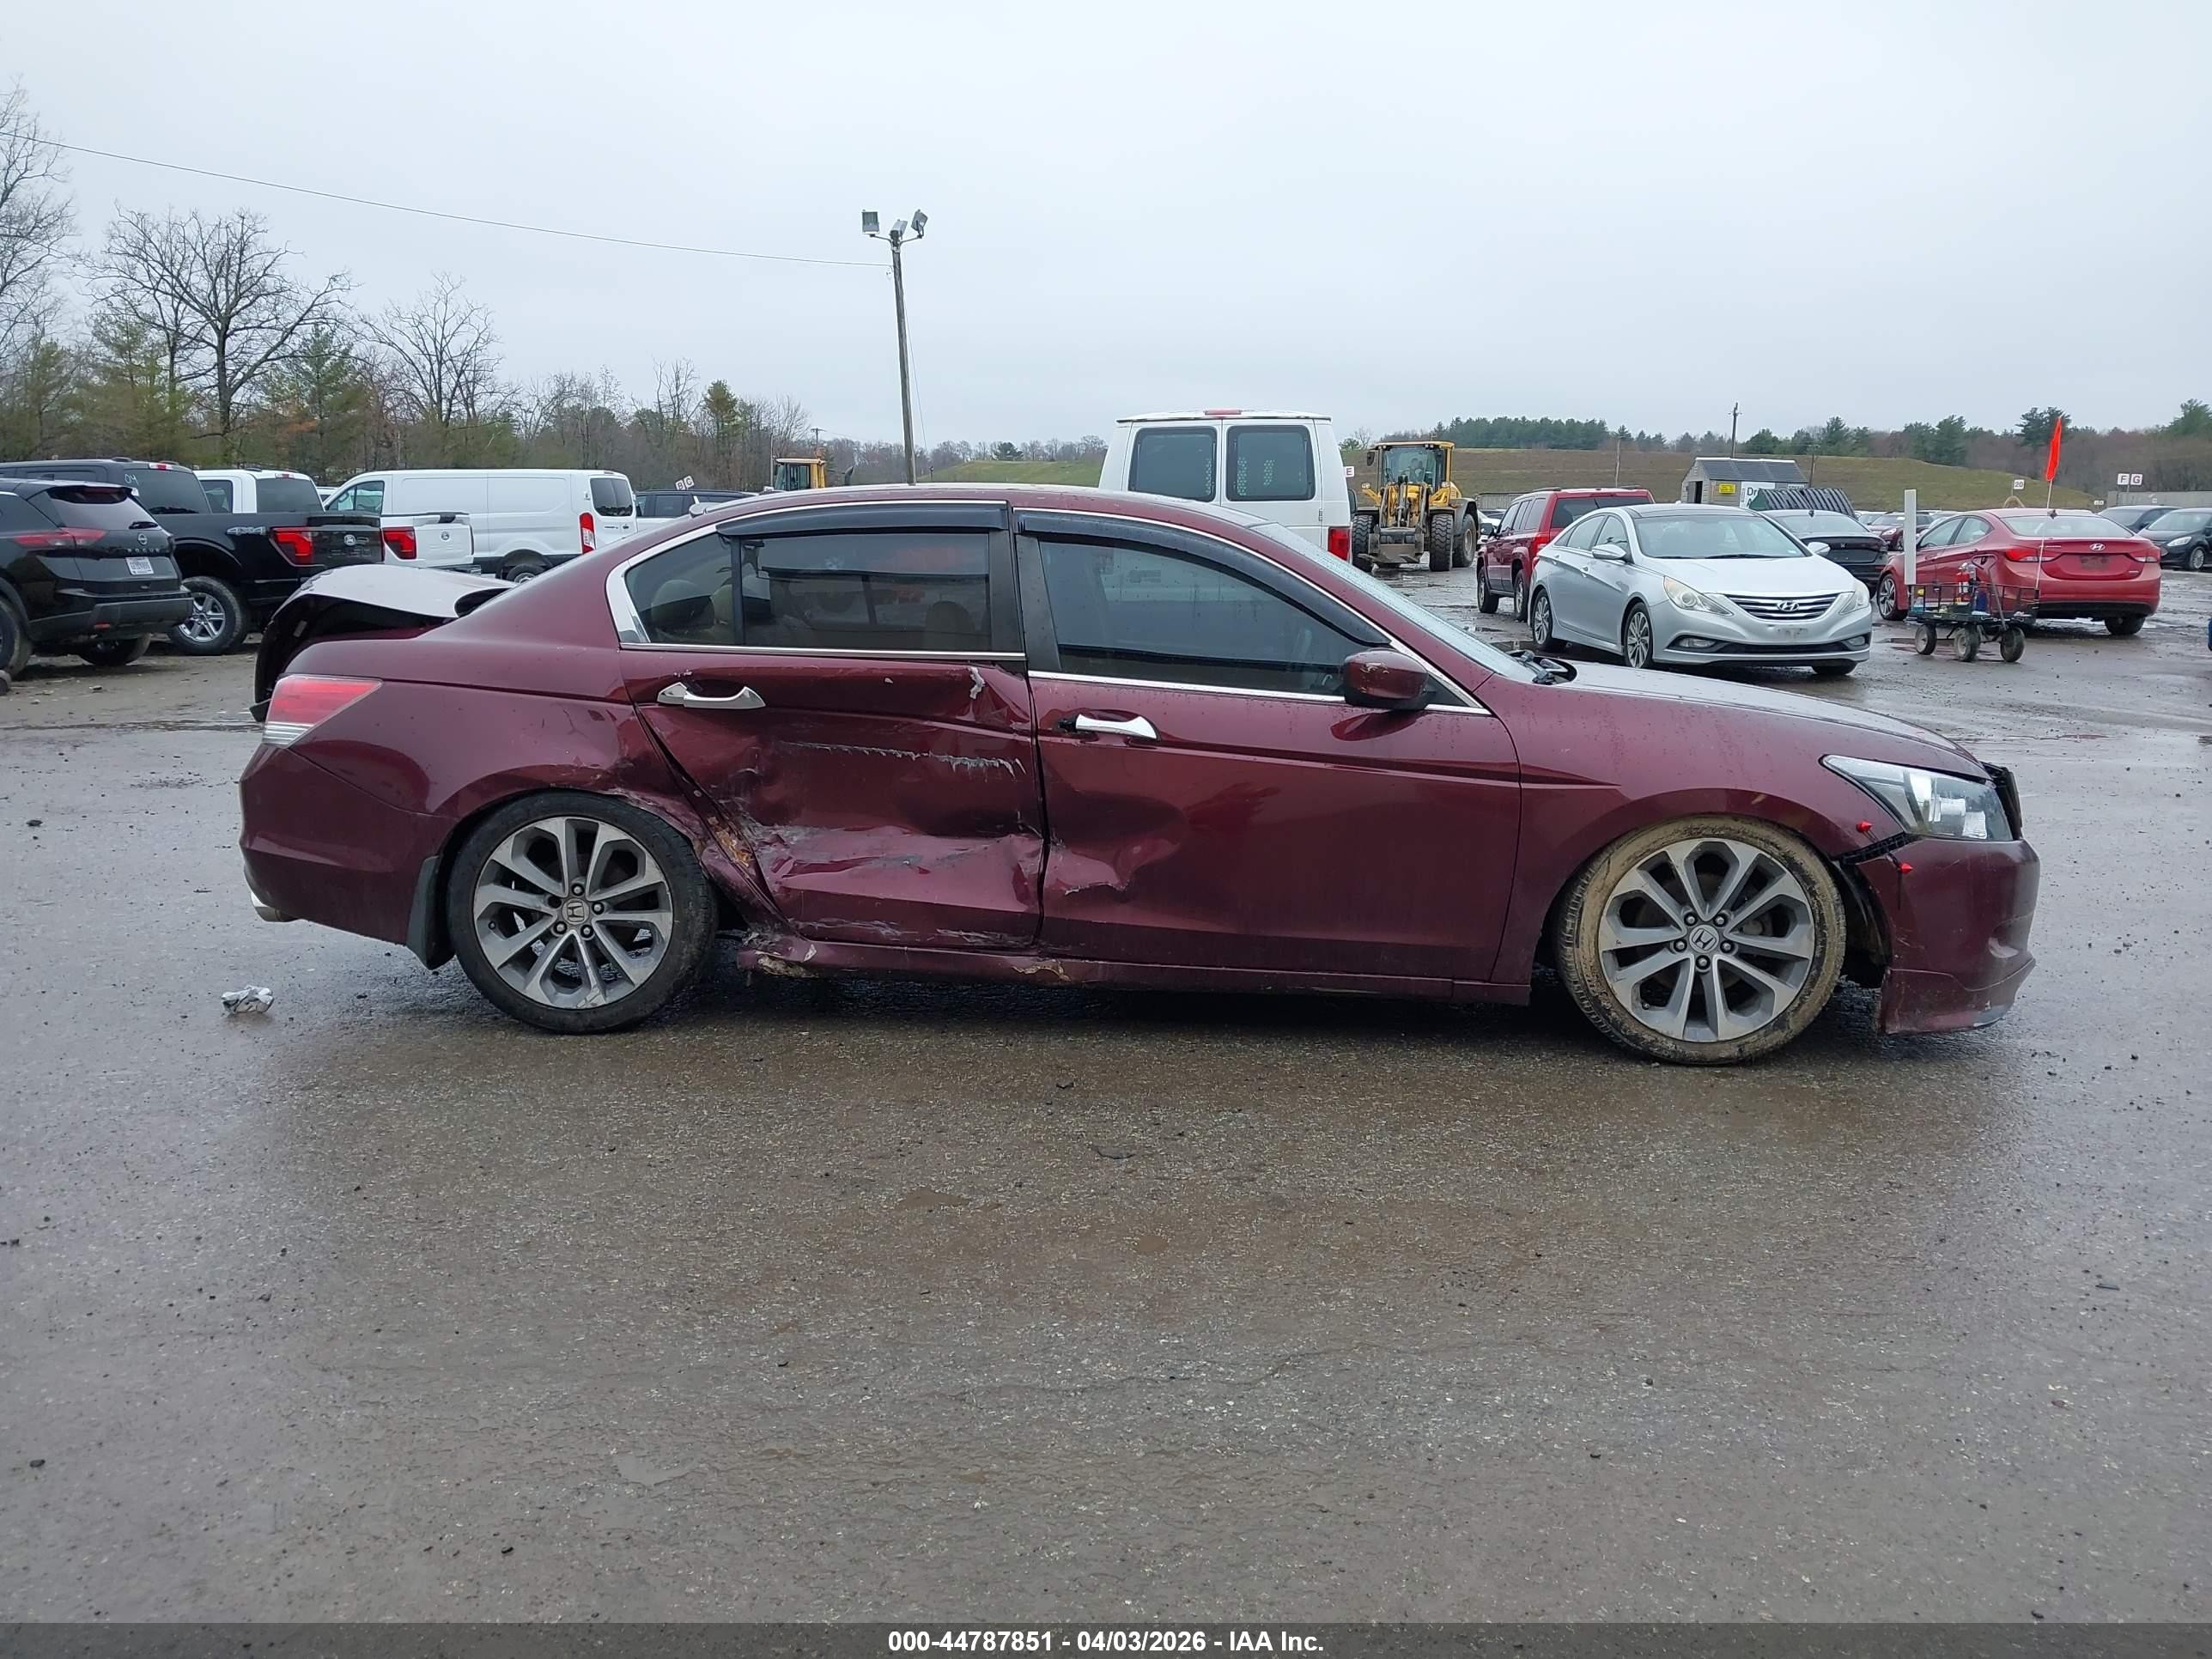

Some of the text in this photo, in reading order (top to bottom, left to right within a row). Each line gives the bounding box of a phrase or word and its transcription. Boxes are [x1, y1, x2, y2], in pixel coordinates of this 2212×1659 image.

[1346, 467, 1353, 476] E
[2120, 475, 2142, 484] F G
